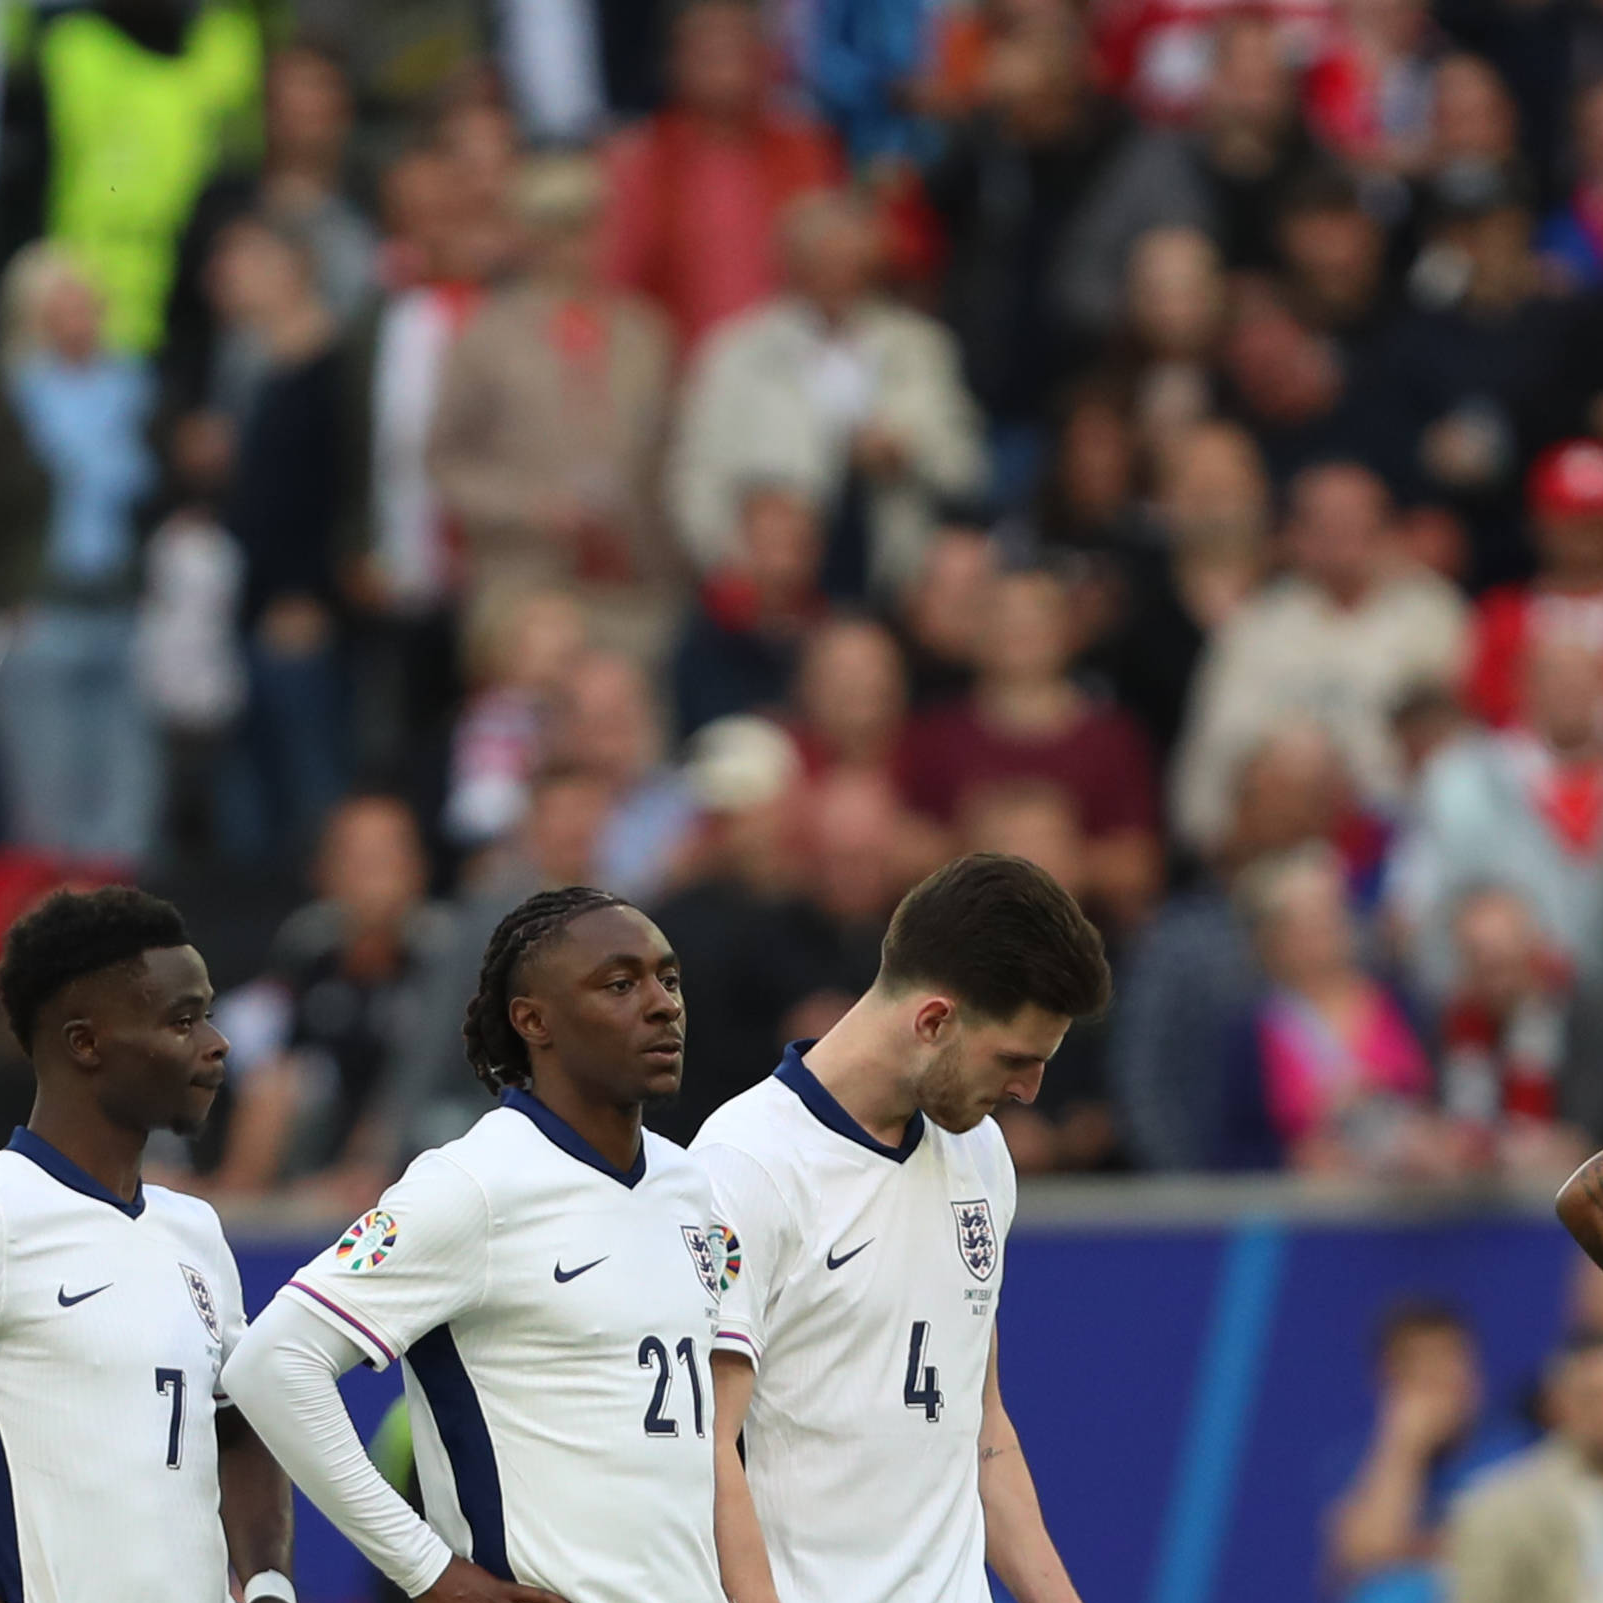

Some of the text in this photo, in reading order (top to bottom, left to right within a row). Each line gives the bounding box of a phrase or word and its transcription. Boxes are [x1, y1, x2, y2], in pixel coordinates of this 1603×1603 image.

[155, 1367, 187, 1470] 7
[638, 1336, 706, 1439] 21
[904, 1321, 945, 1424] 4
